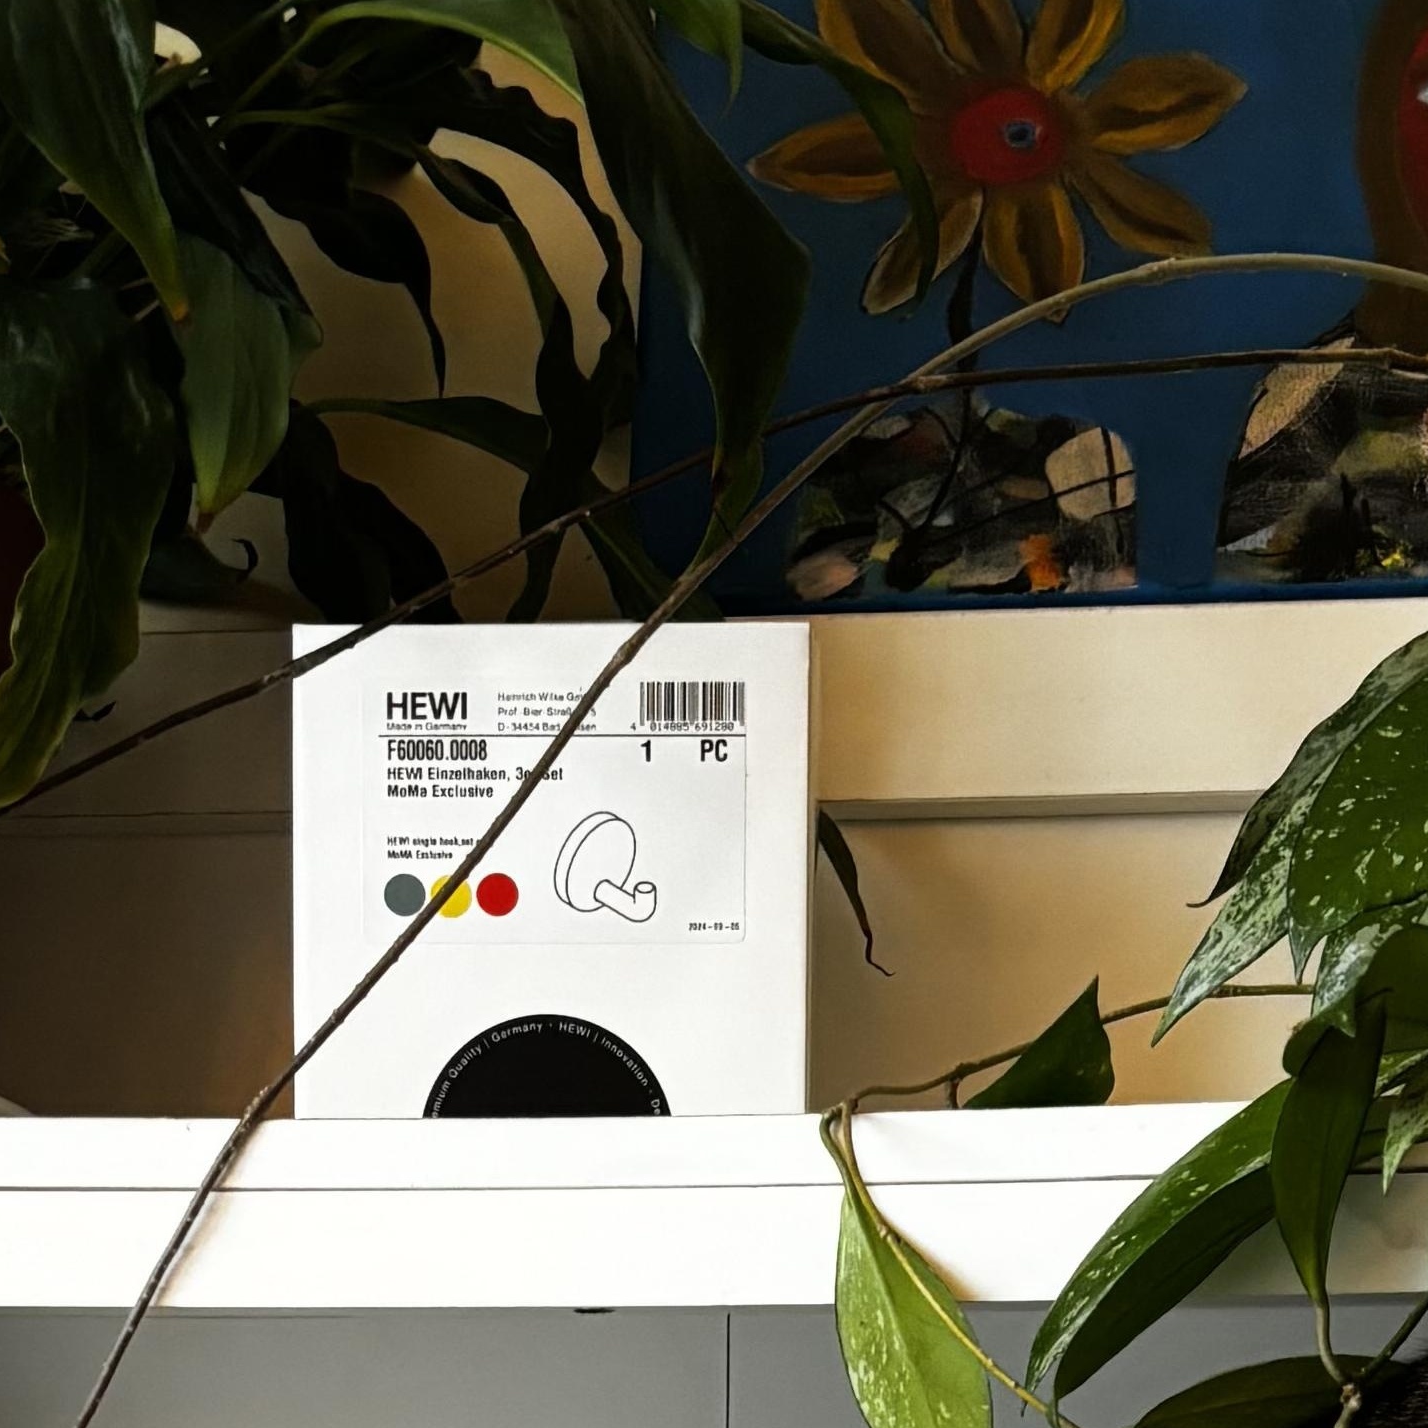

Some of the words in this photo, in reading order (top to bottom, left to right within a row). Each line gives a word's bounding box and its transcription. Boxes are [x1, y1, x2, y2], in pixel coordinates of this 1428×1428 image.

[386, 692, 468, 720] HEWI
[387, 739, 489, 761] F60060.0008
[639, 740, 652, 762] 1
[700, 739, 728, 762] PC
[387, 767, 424, 781] HEWI
[428, 767, 512, 782] Einzelhaken,
[387, 785, 428, 799] MoMa
[431, 785, 495, 799] Exclusive
[448, 1044, 483, 1080] Quality
[491, 1023, 542, 1043] Germany
[559, 1021, 591, 1038] HEWI
[602, 1037, 649, 1087] Innovation
